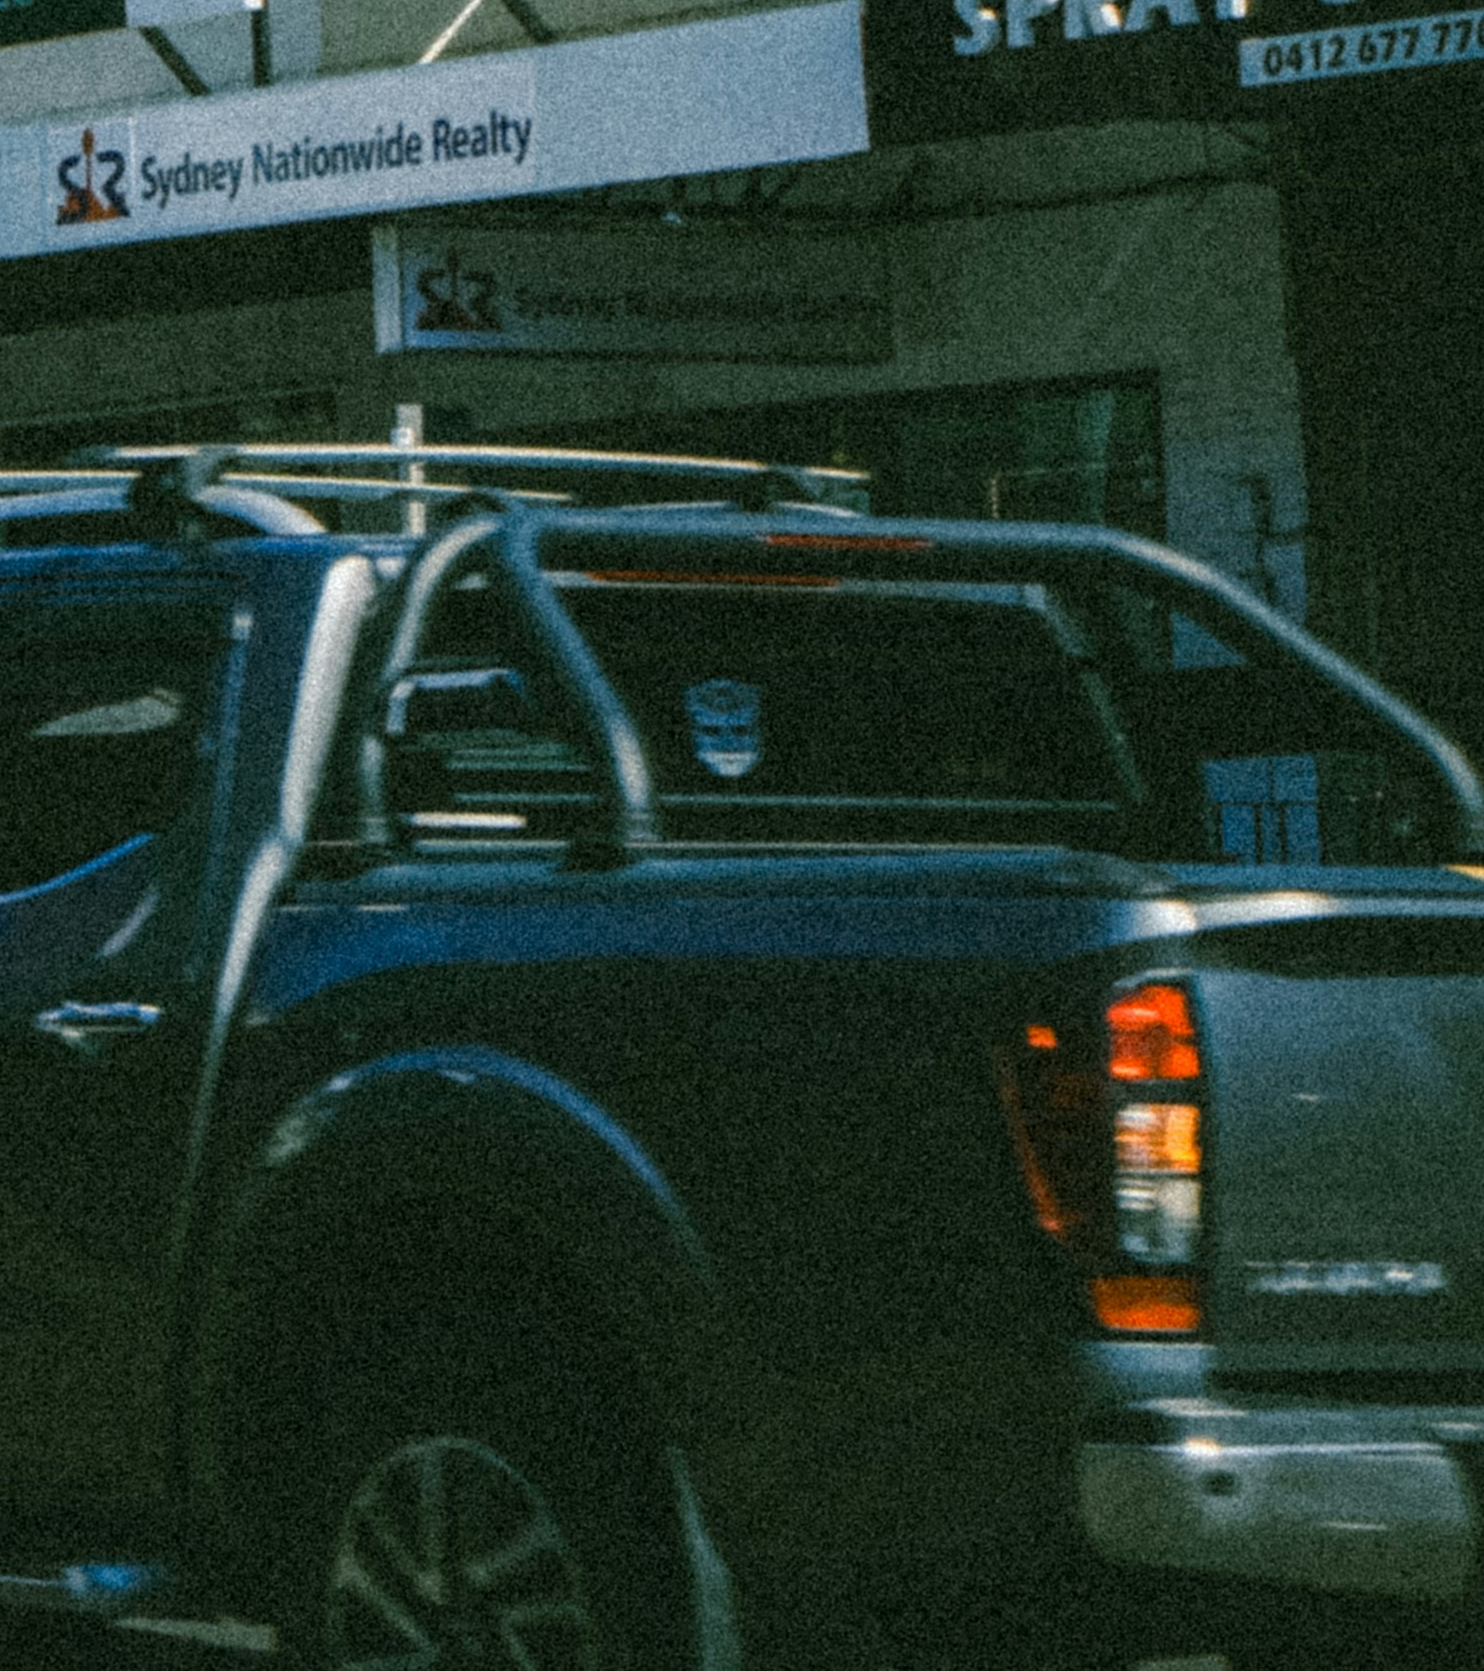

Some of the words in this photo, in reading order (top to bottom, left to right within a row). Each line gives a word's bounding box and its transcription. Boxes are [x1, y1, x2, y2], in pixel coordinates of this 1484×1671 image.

[1262, 33, 1347, 77] 0412
[1358, 26, 1421, 65] 677
[140, 152, 245, 210] Sydney
[252, 122, 423, 186] Nationwide
[432, 108, 533, 165] Realty
